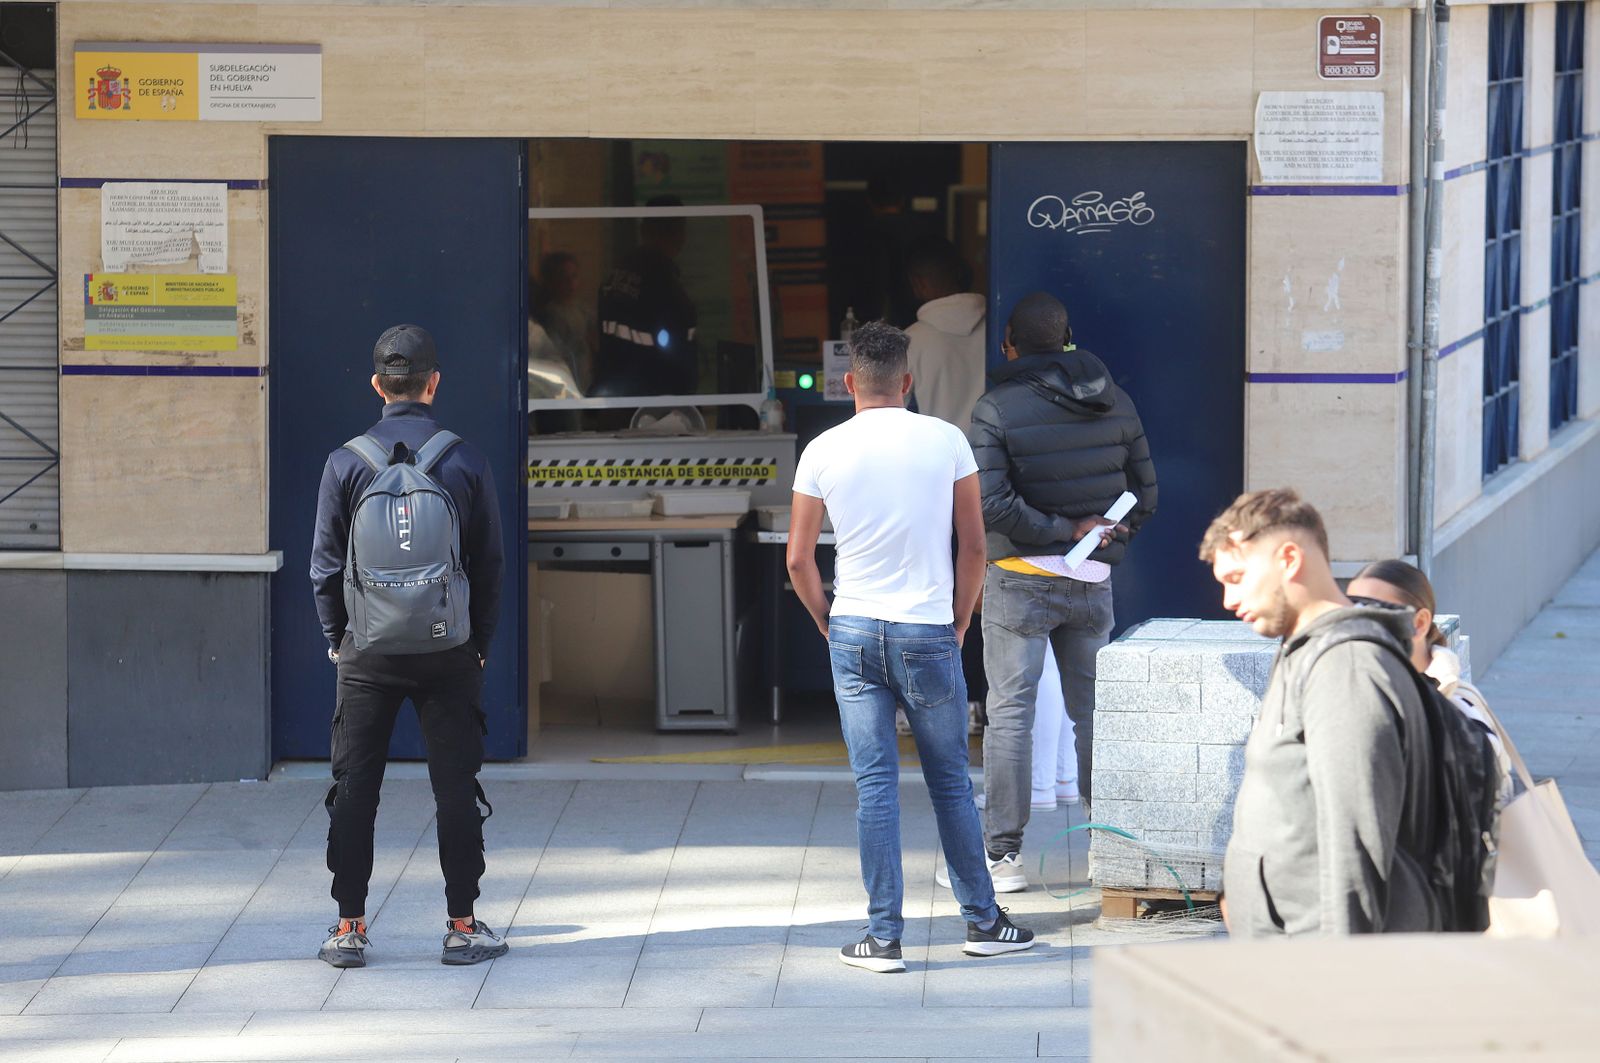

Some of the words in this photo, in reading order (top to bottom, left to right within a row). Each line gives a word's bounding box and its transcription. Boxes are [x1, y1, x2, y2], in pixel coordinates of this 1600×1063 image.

[210, 63, 276, 72] SUBDELEGACIÓN
[139, 78, 184, 86] GOBIERNO
[210, 74, 225, 82] DEL
[227, 74, 270, 82] GOBIERNO
[139, 88, 150, 97] DE
[152, 87, 184, 97] ESPAÑA
[210, 84, 221, 92] EN
[223, 84, 253, 92] HUELVA
[587, 468, 602, 478] LA
[607, 468, 673, 478] DISTANCIA
[678, 467, 693, 477] DE
[698, 467, 769, 477] SEGURIDAD
